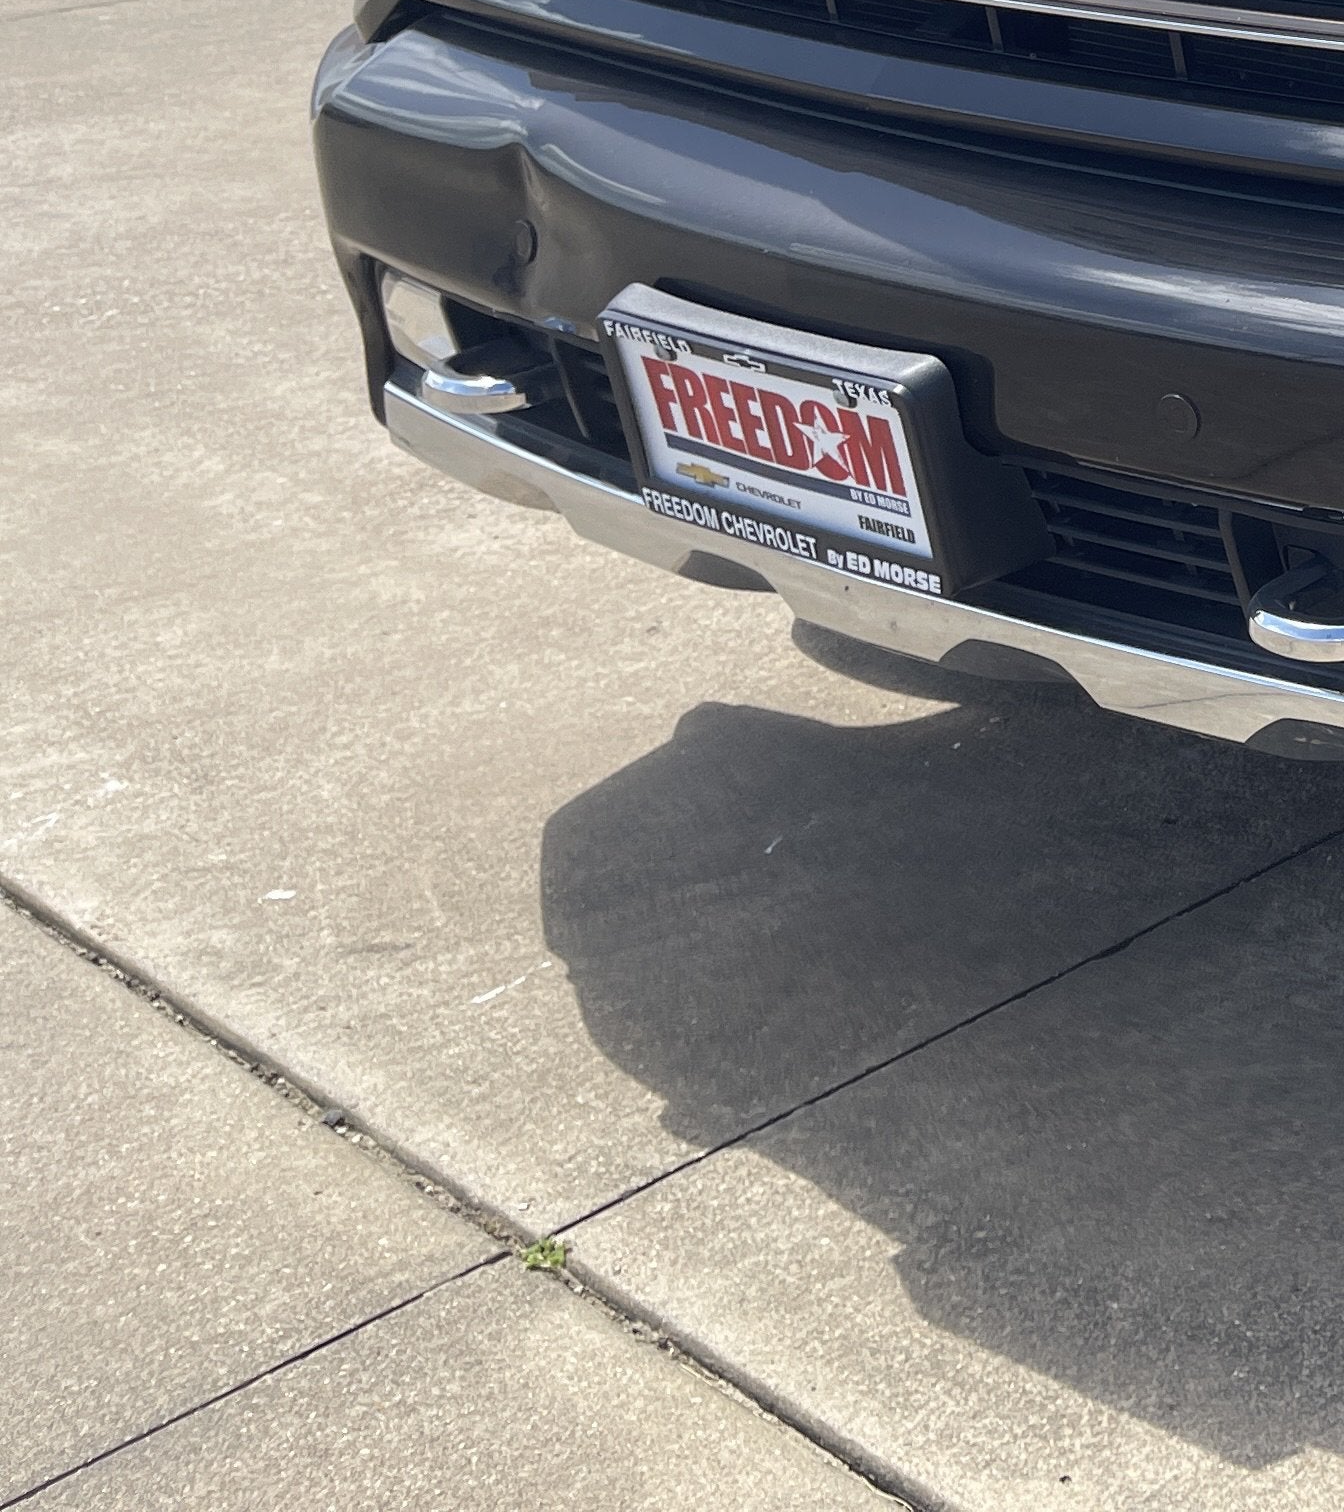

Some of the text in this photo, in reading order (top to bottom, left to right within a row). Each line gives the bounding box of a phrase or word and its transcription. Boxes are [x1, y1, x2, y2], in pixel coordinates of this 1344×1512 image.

[603, 319, 892, 406] FAIRFIELD TEXAS
[641, 356, 907, 497] FREEDOM
[736, 481, 801, 509] CHEVROLET
[849, 488, 909, 515] BY ED MORSE
[643, 488, 719, 530] FREEDOM
[721, 511, 817, 559] CHEVROLET
[846, 551, 871, 574] ED
[873, 559, 942, 594] MORSE
[857, 514, 916, 544] FAIRFIELD
